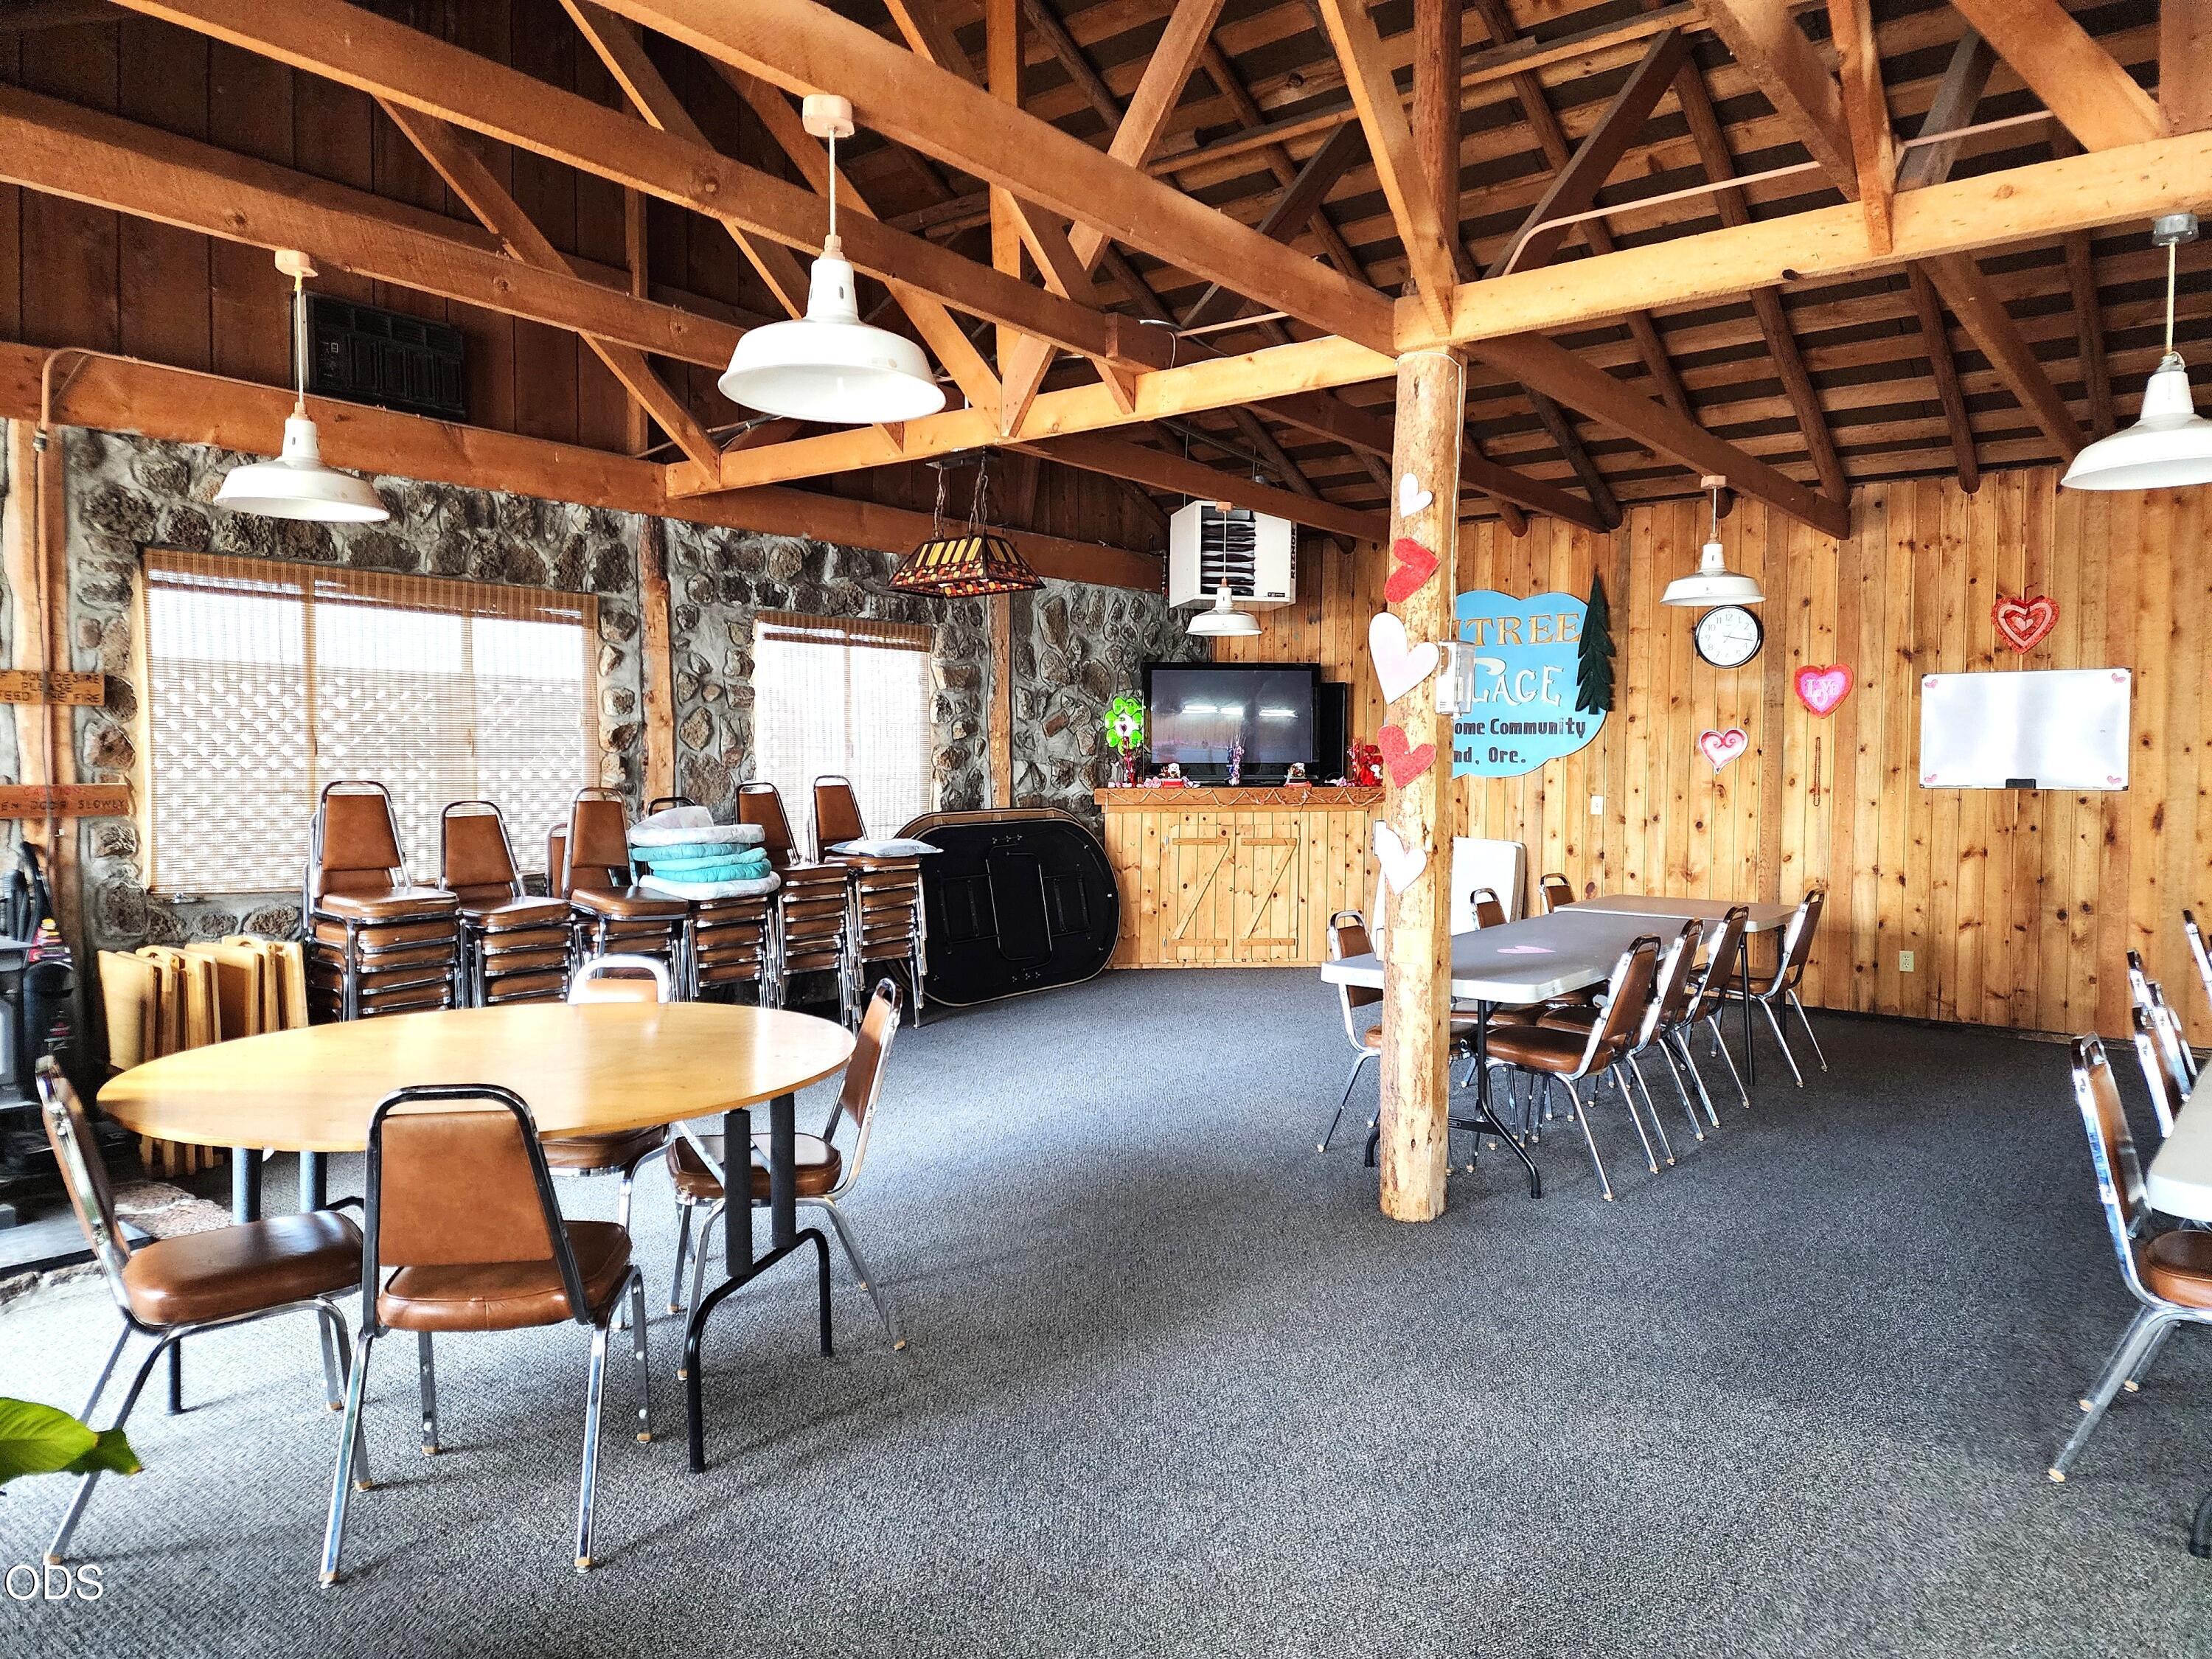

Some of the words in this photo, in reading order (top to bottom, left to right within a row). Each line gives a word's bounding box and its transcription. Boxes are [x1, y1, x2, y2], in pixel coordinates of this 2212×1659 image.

[1455, 613, 1582, 646] TREE
[1454, 722, 1485, 735] ome
[1490, 717, 1585, 738] Community
[1453, 747, 1479, 765] nd,
[1488, 747, 1526, 764] Ore.
[77, 799, 125, 810] SLOWLY
